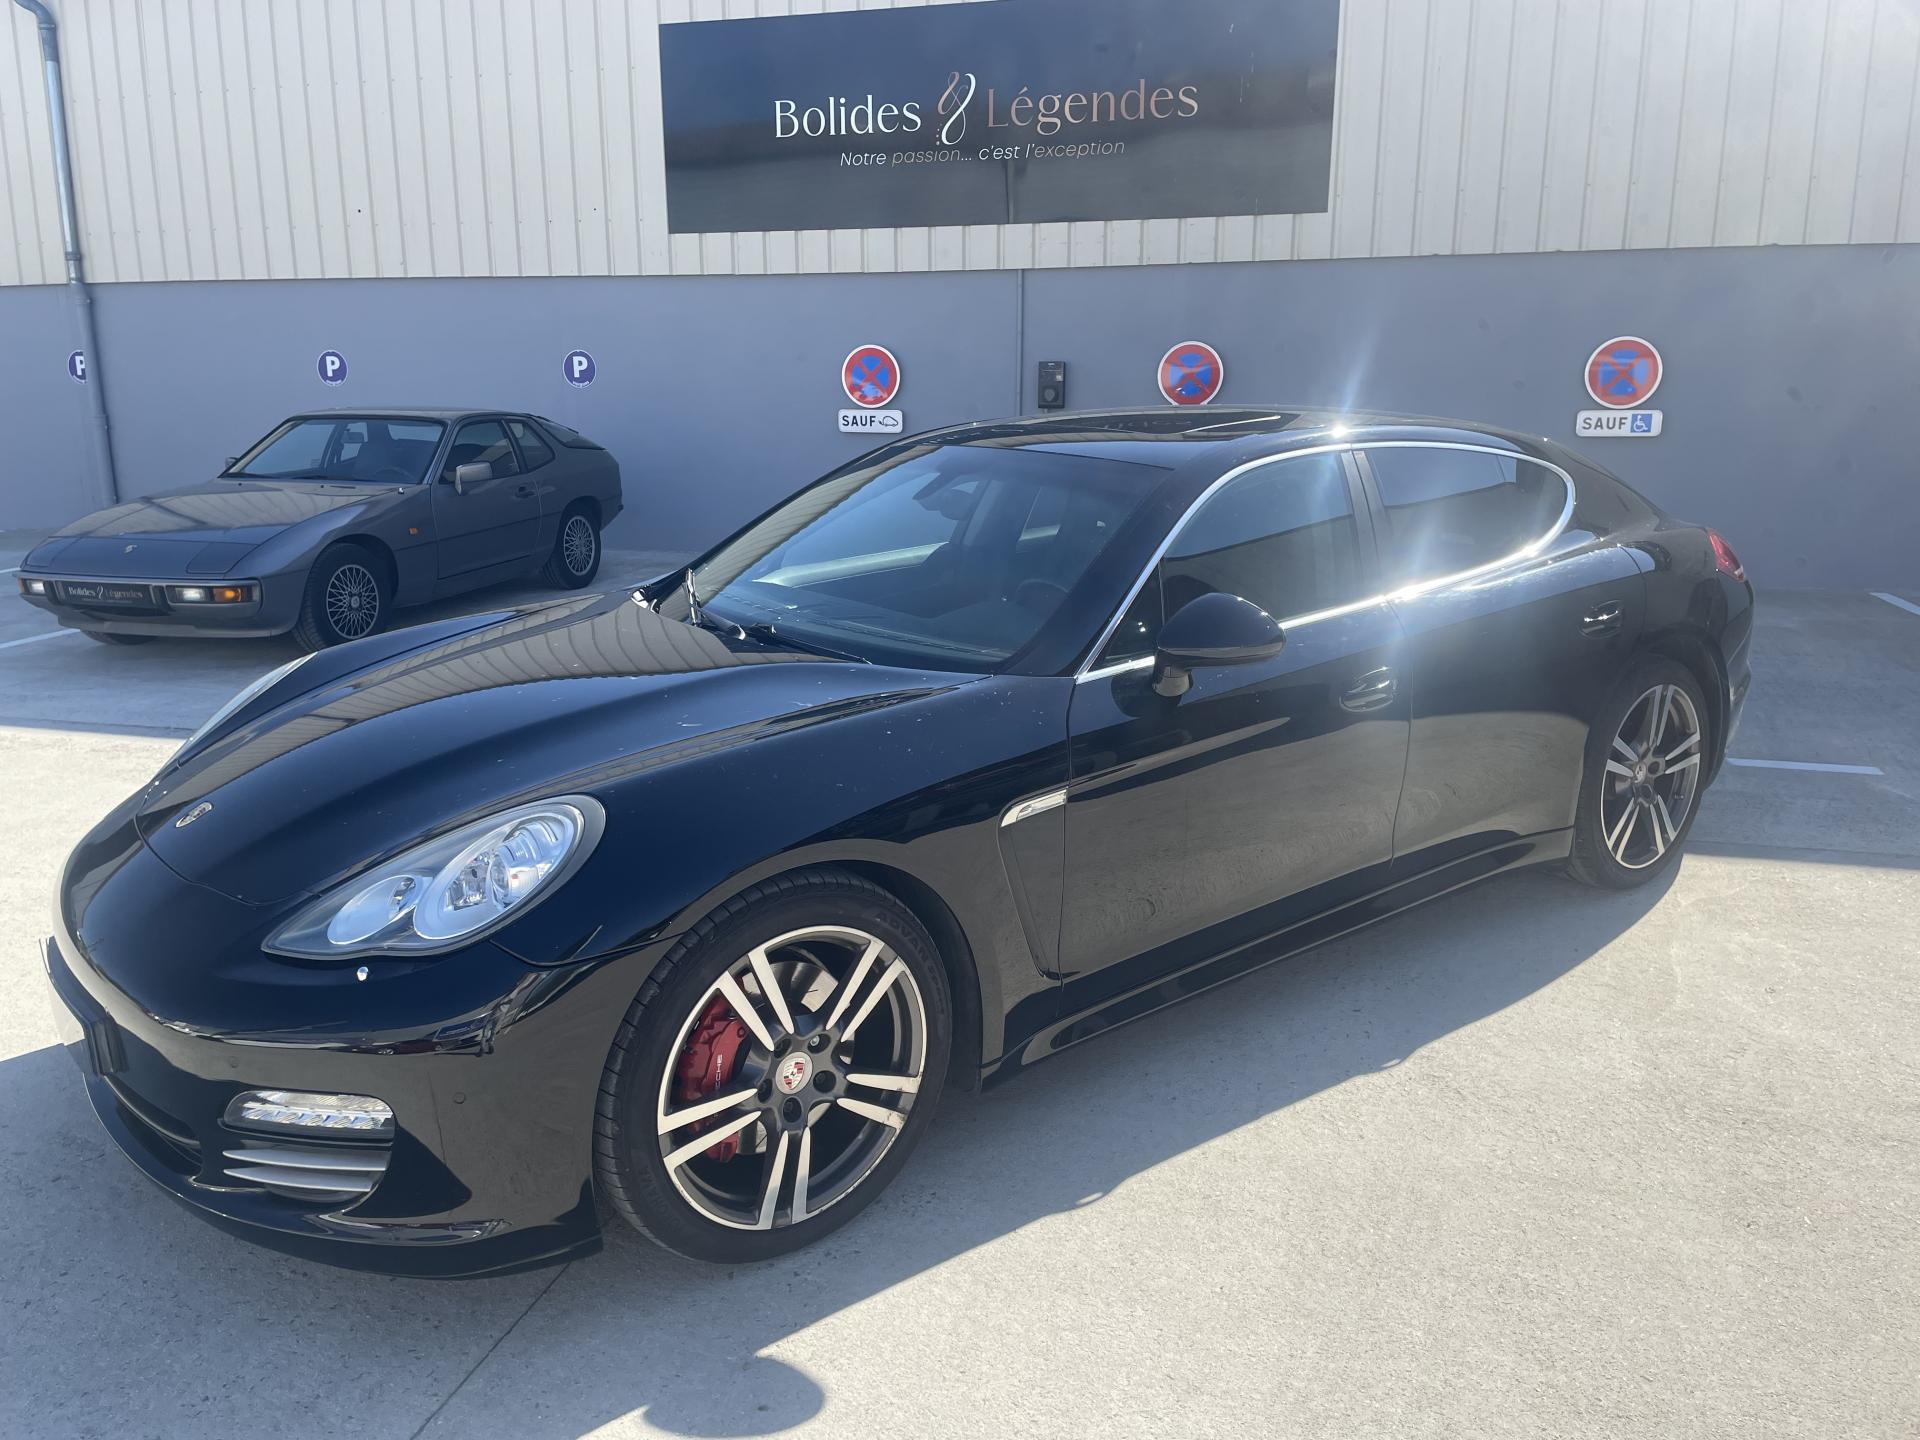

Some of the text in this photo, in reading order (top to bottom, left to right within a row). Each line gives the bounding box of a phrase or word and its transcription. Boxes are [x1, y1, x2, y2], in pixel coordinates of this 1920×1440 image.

[774, 94, 922, 138] Bolides
[987, 78, 1199, 136] Légendes
[840, 139, 1125, 168] Notre passion... c'est l'exception
[75, 355, 86, 376] P
[325, 355, 341, 377] P
[572, 355, 588, 378] P
[842, 415, 876, 427] SAUF
[1582, 416, 1628, 431] SAUF
